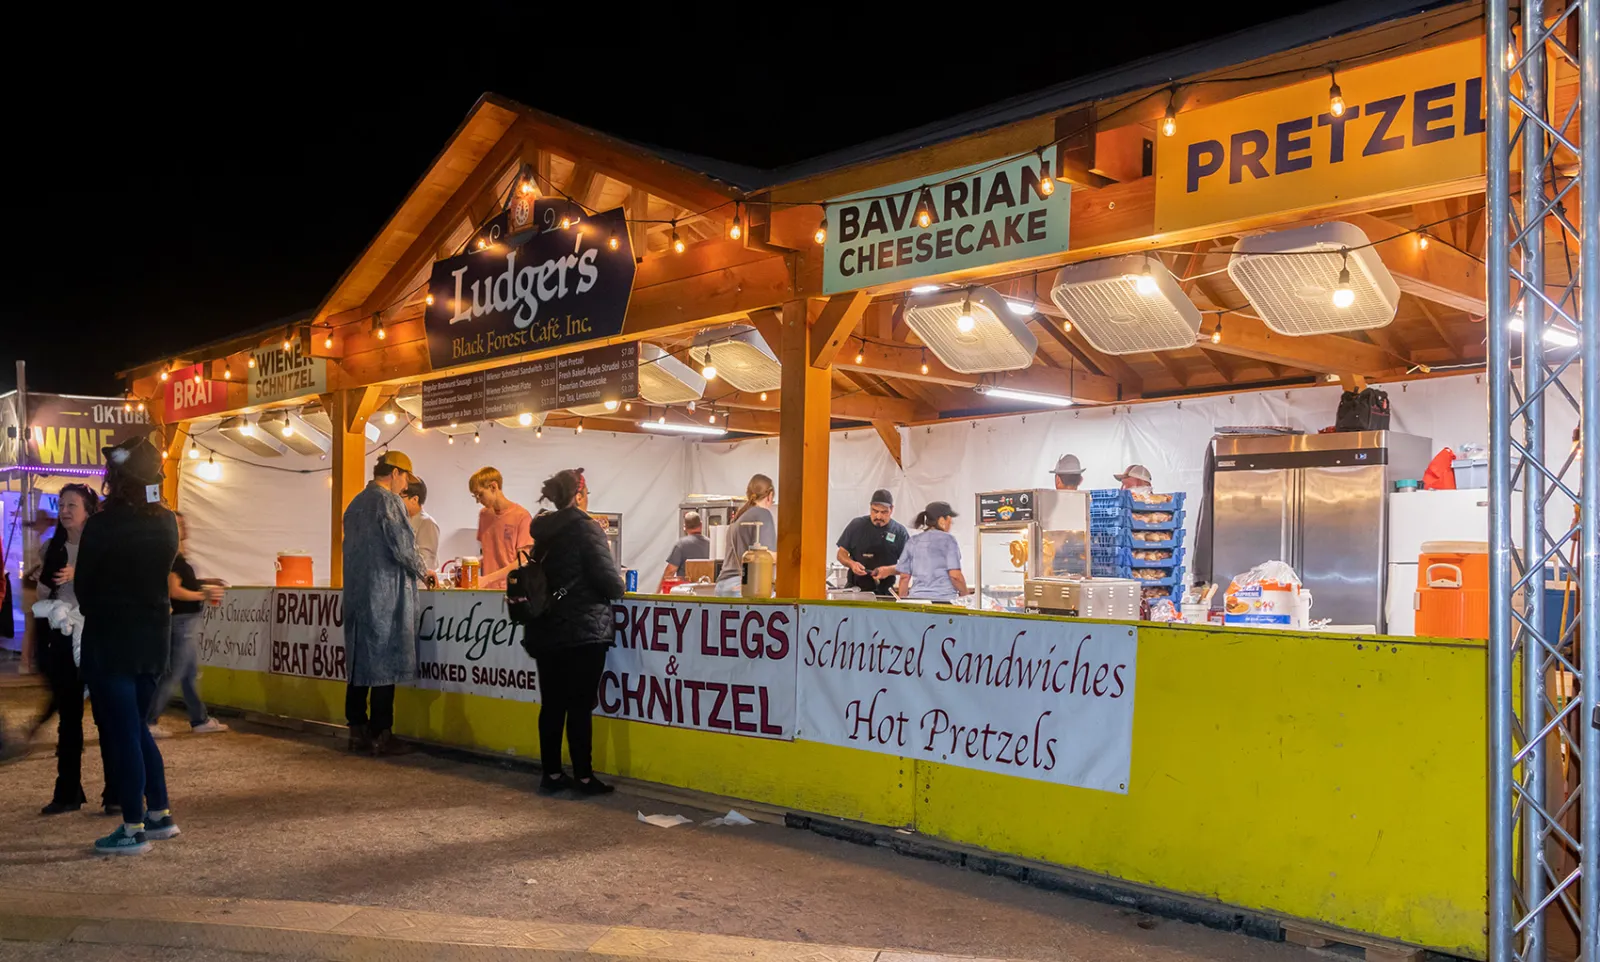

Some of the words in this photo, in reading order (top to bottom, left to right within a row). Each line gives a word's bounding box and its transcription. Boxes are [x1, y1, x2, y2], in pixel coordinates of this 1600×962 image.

[1187, 77, 1486, 193] PRETZEL
[839, 160, 1051, 243] BAVARIAN
[839, 209, 1047, 277] CHEESECAKE
[449, 232, 598, 329] Ludger's
[452, 334, 484, 359] Black
[487, 328, 527, 355] Forest
[530, 317, 562, 345] Café,
[565, 314, 592, 336] Inc.
[558, 360, 567, 368] Hot
[568, 355, 584, 366] Pretzel
[558, 370, 571, 380] Fresh
[572, 367, 586, 377] Baked
[587, 364, 601, 376] Apple
[601, 360, 620, 372] Strudel
[174, 376, 212, 410] BRAT
[256, 369, 315, 398] SCHNITZEL
[559, 380, 578, 391] Bavarian
[579, 376, 607, 388] Cheesecake
[576, 388, 601, 400] Lemonade
[485, 404, 502, 413] Smoked
[34, 426, 115, 465] WINE
[227, 599, 270, 622] Cheesecake
[276, 593, 343, 627] BRATWU
[223, 631, 258, 657] Strudel
[320, 628, 329, 643] &
[419, 602, 525, 661] Ludger
[614, 604, 692, 653] RKEY
[701, 609, 790, 660] LEGS
[273, 641, 308, 675] BRAT
[312, 643, 346, 679] BUR
[665, 655, 679, 676] &
[804, 617, 936, 678] Schnitzel
[935, 630, 1126, 698] Sandwiches
[417, 661, 467, 683] MOKED
[472, 666, 536, 690] SAUSAGE
[593, 670, 782, 735] CHNITZEL
[846, 688, 909, 746] Hot
[920, 709, 1057, 770] Pretzels
